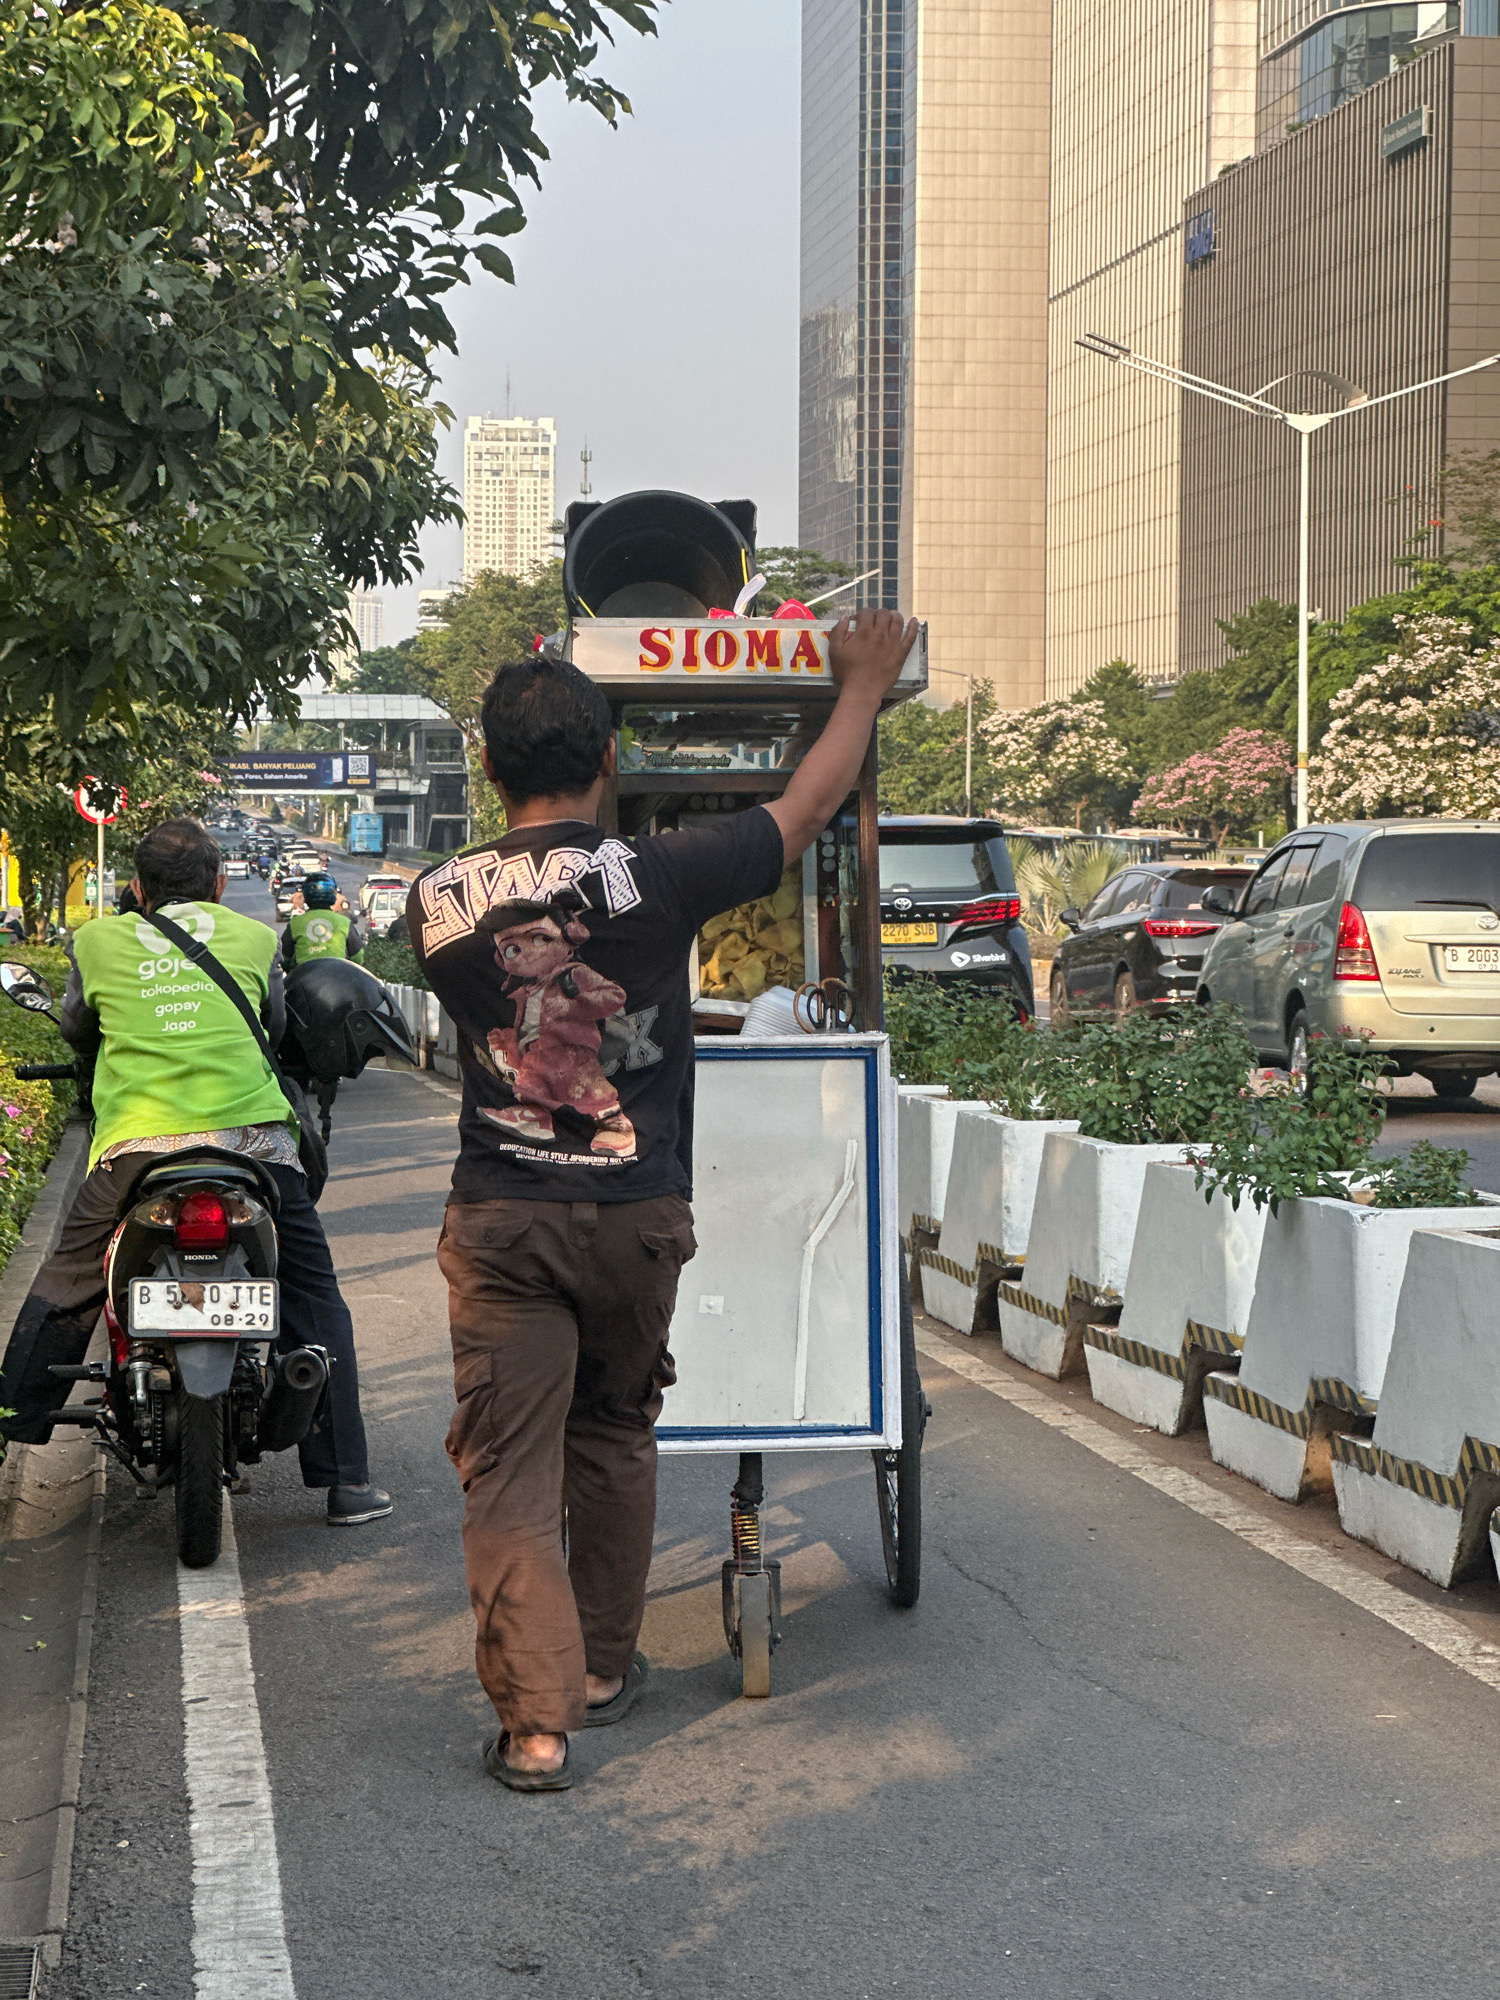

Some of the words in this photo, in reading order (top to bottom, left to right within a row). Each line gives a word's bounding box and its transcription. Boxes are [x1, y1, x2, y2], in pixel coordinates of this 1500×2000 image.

[639, 627, 838, 673] SIOMA
[253, 762, 282, 770] BANYAK
[282, 762, 317, 770] PELUANG
[419, 838, 642, 960] START
[882, 923, 909, 937] 2270
[914, 922, 935, 936] SUB
[972, 953, 1006, 963] Silverbird
[1450, 948, 1459, 962] B
[1467, 948, 1499, 963] 2003
[138, 957, 202, 981] goje
[141, 981, 214, 998] tokopedia
[155, 1001, 202, 1017] gopay
[161, 1020, 197, 1032] Jago
[537, 1149, 550, 1159] LIFE
[550, 1152, 569, 1161] STYLE
[140, 1286, 150, 1304] B
[166, 1285, 220, 1305] 50
